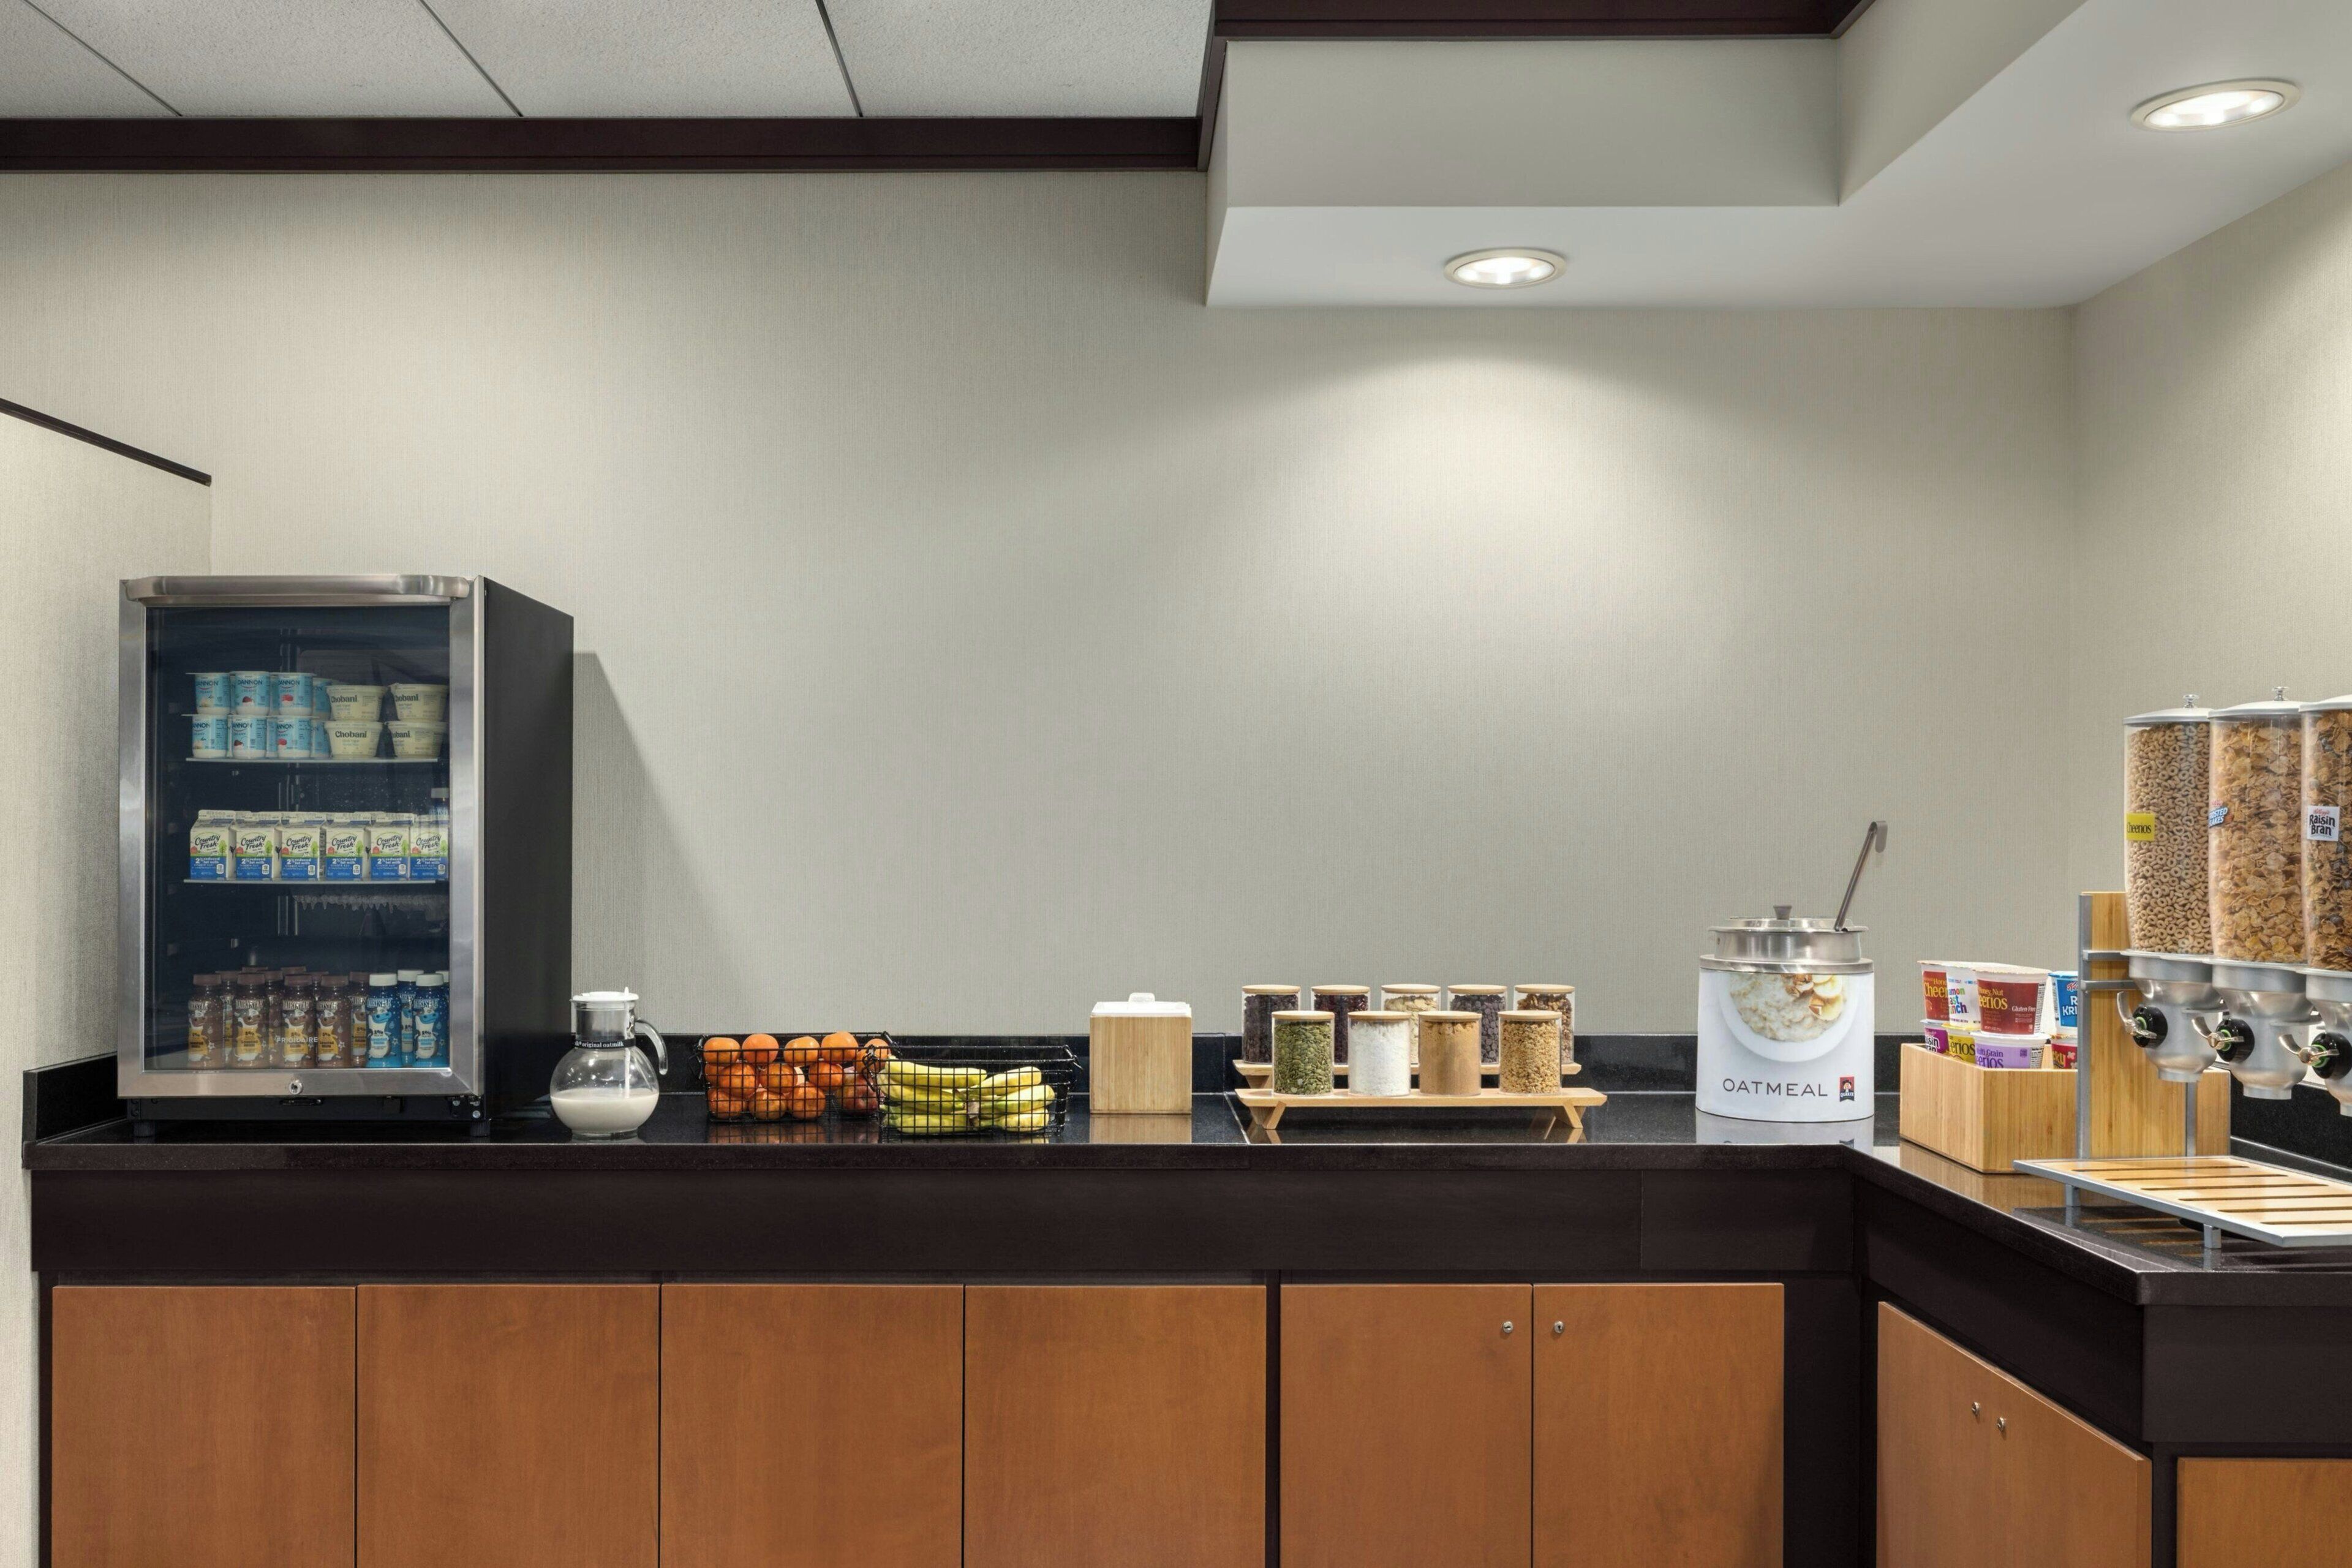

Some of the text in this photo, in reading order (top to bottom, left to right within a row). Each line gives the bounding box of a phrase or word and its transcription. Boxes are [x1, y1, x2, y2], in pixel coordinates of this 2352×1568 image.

[331, 695, 358, 703] Chobani
[335, 730, 368, 739] Chobani
[2309, 814, 2336, 827] Raisin
[2311, 824, 2332, 837] Bran
[195, 835, 221, 846] Country
[200, 841, 219, 850] Fresh
[241, 835, 266, 846] Country
[246, 842, 264, 850] Fresh
[286, 836, 312, 846] Country
[331, 835, 358, 846] Country
[337, 842, 355, 850] Fresh
[377, 835, 402, 846] Country
[382, 841, 400, 850] Fresh
[416, 835, 441, 846] Country
[421, 841, 440, 850] Fresh
[291, 842, 309, 851] Fresh
[1978, 995, 2008, 1009] eerios
[2062, 1005, 2078, 1016] KRI
[1951, 1041, 1975, 1056] erios
[1986, 1049, 2003, 1058] Grain
[1722, 1078, 1828, 1097] OATMEAL
